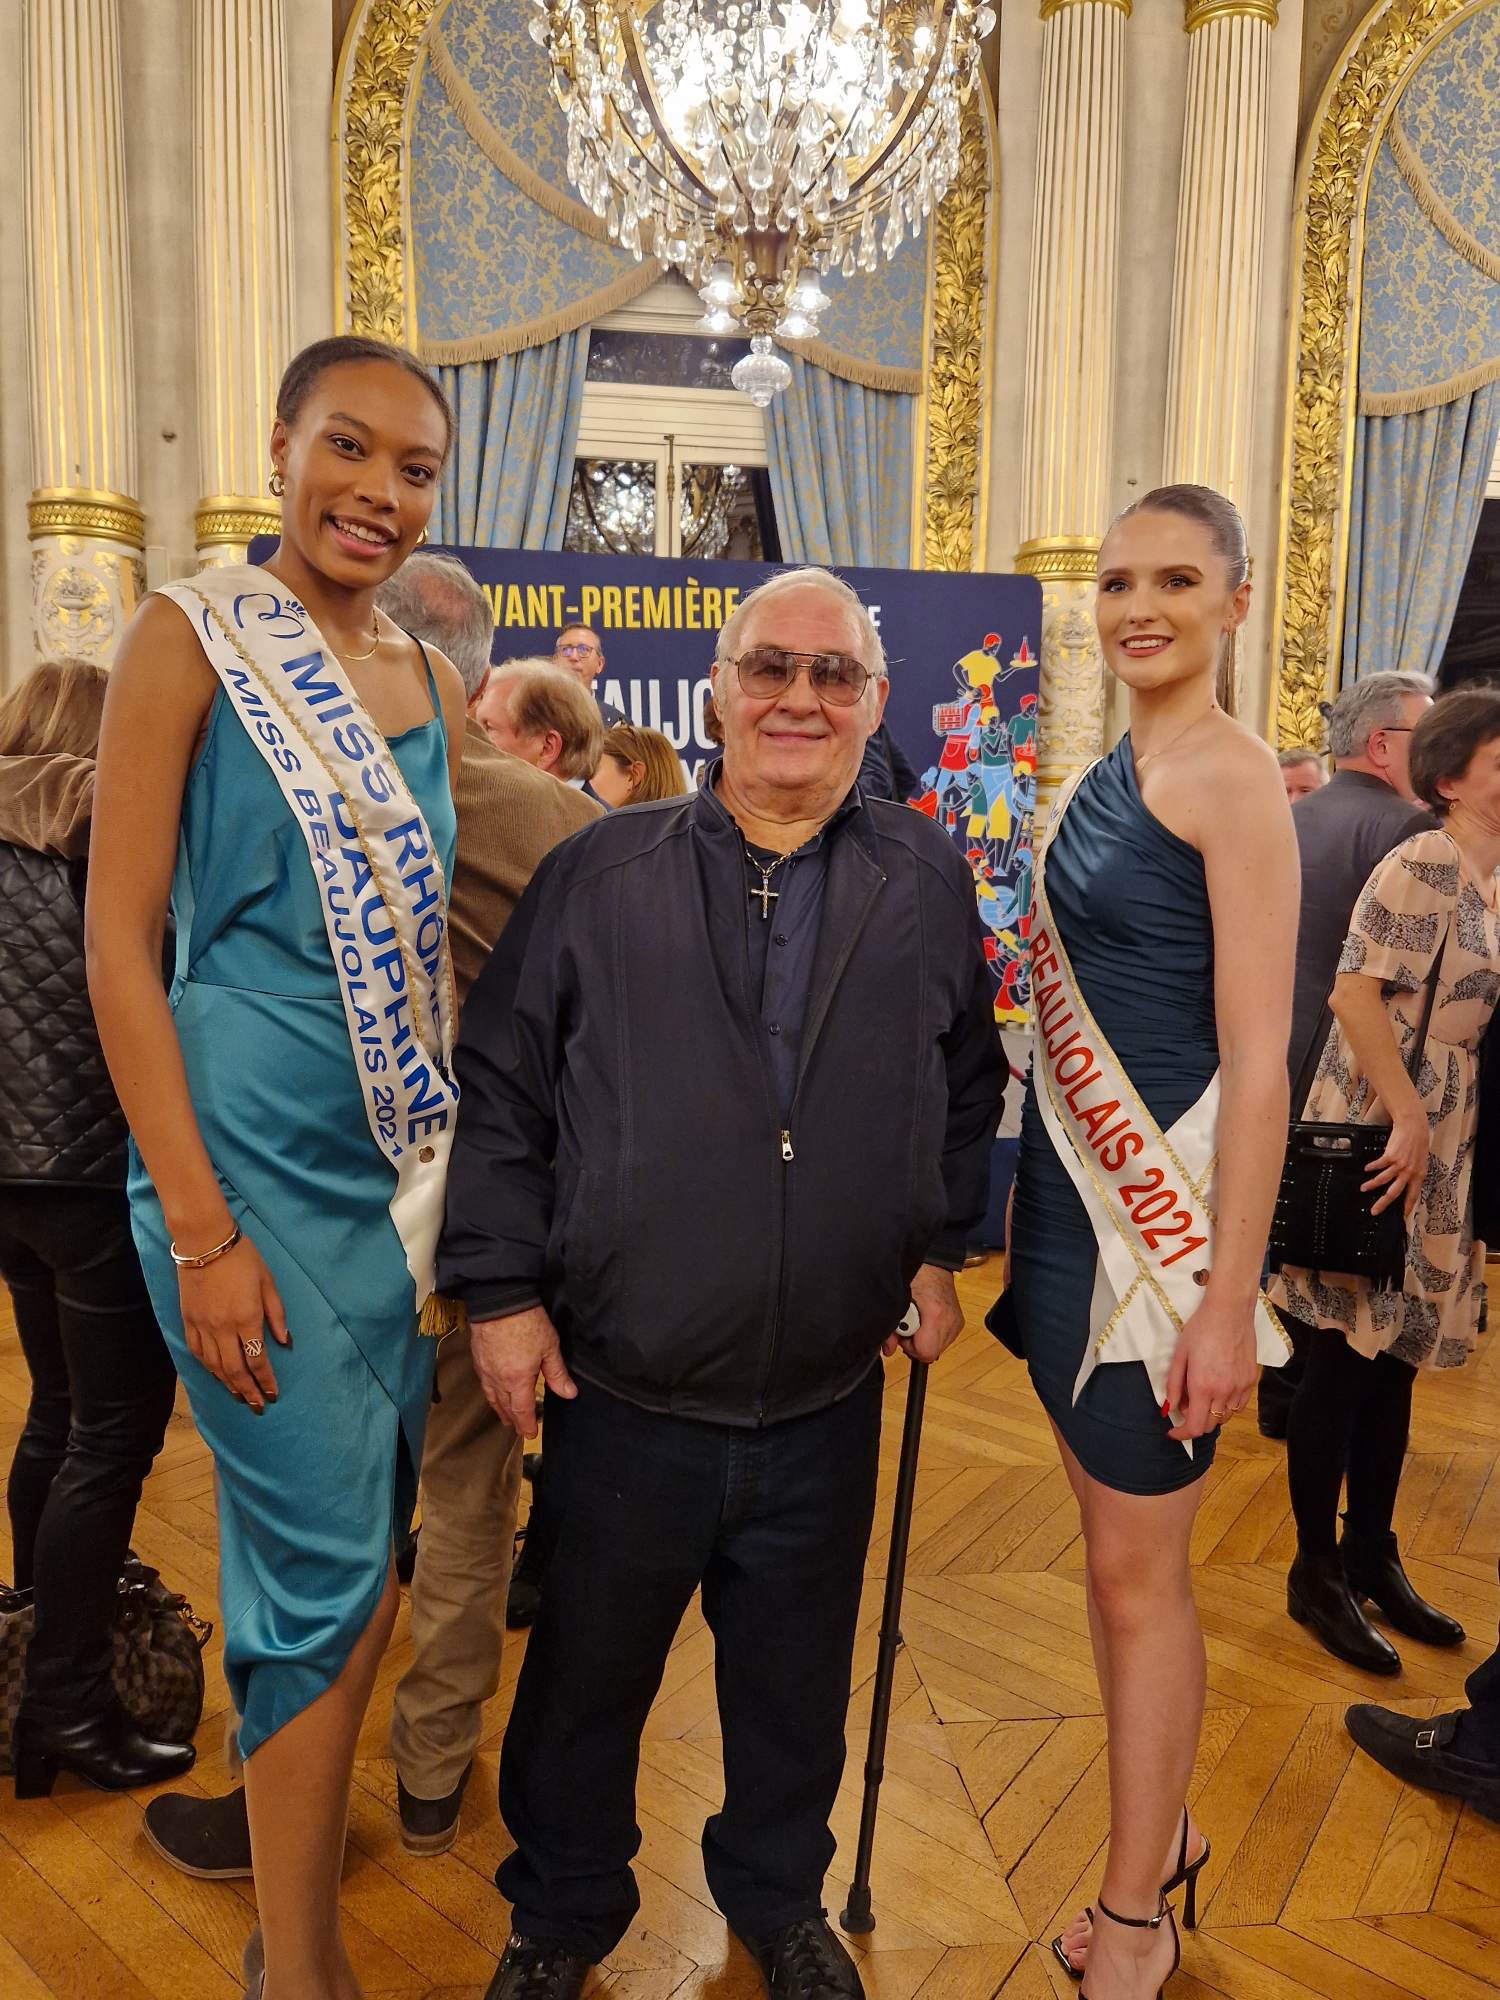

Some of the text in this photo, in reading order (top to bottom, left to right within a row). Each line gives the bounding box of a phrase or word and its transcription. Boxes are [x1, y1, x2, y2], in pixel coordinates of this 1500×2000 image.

[482, 576, 739, 628] VANT-PREMIÈRE
[280, 651, 397, 804] MISS
[225, 668, 302, 773] MISS
[291, 788, 387, 1074] BEAUJOLAIS
[1030, 928, 1208, 1268] BEAUJOLAIS 2021
